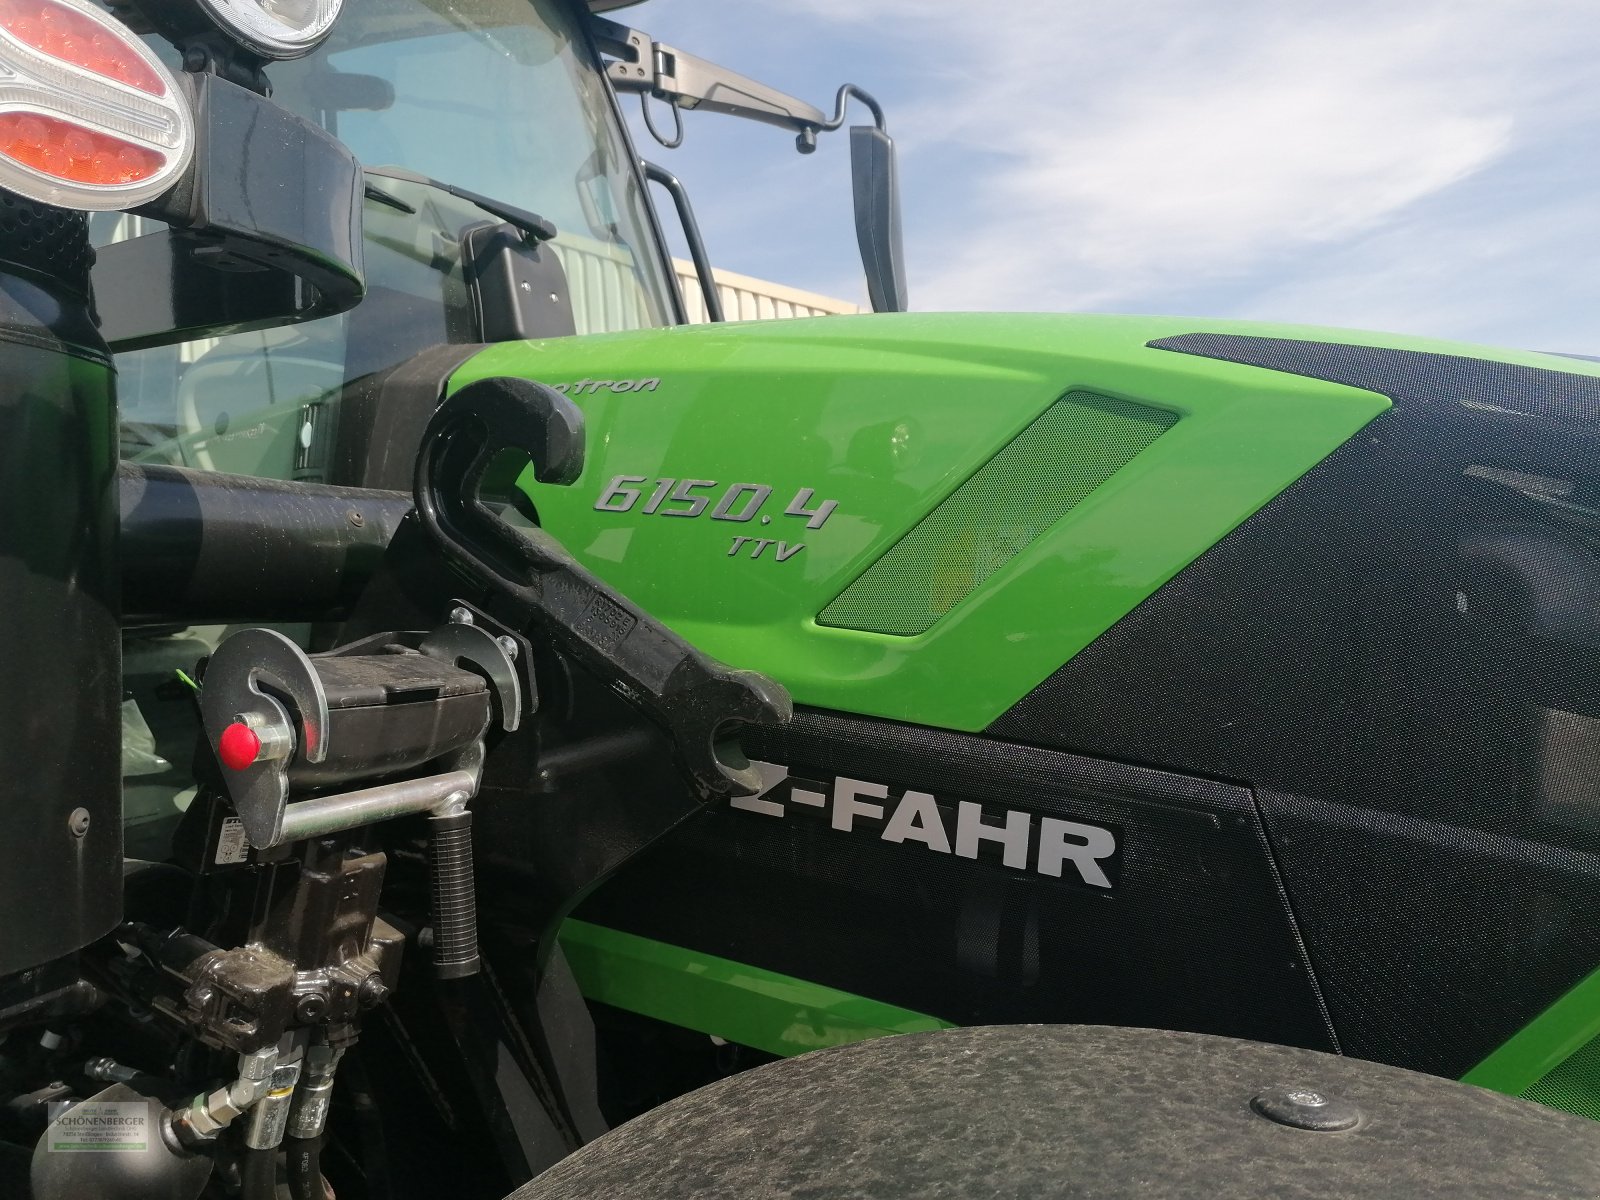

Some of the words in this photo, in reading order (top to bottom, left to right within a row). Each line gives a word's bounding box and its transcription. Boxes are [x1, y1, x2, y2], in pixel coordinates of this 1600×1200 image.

[593, 475, 839, 530] 6150.4
[728, 536, 805, 562] TTV
[731, 759, 1116, 888] Z-FAHR
